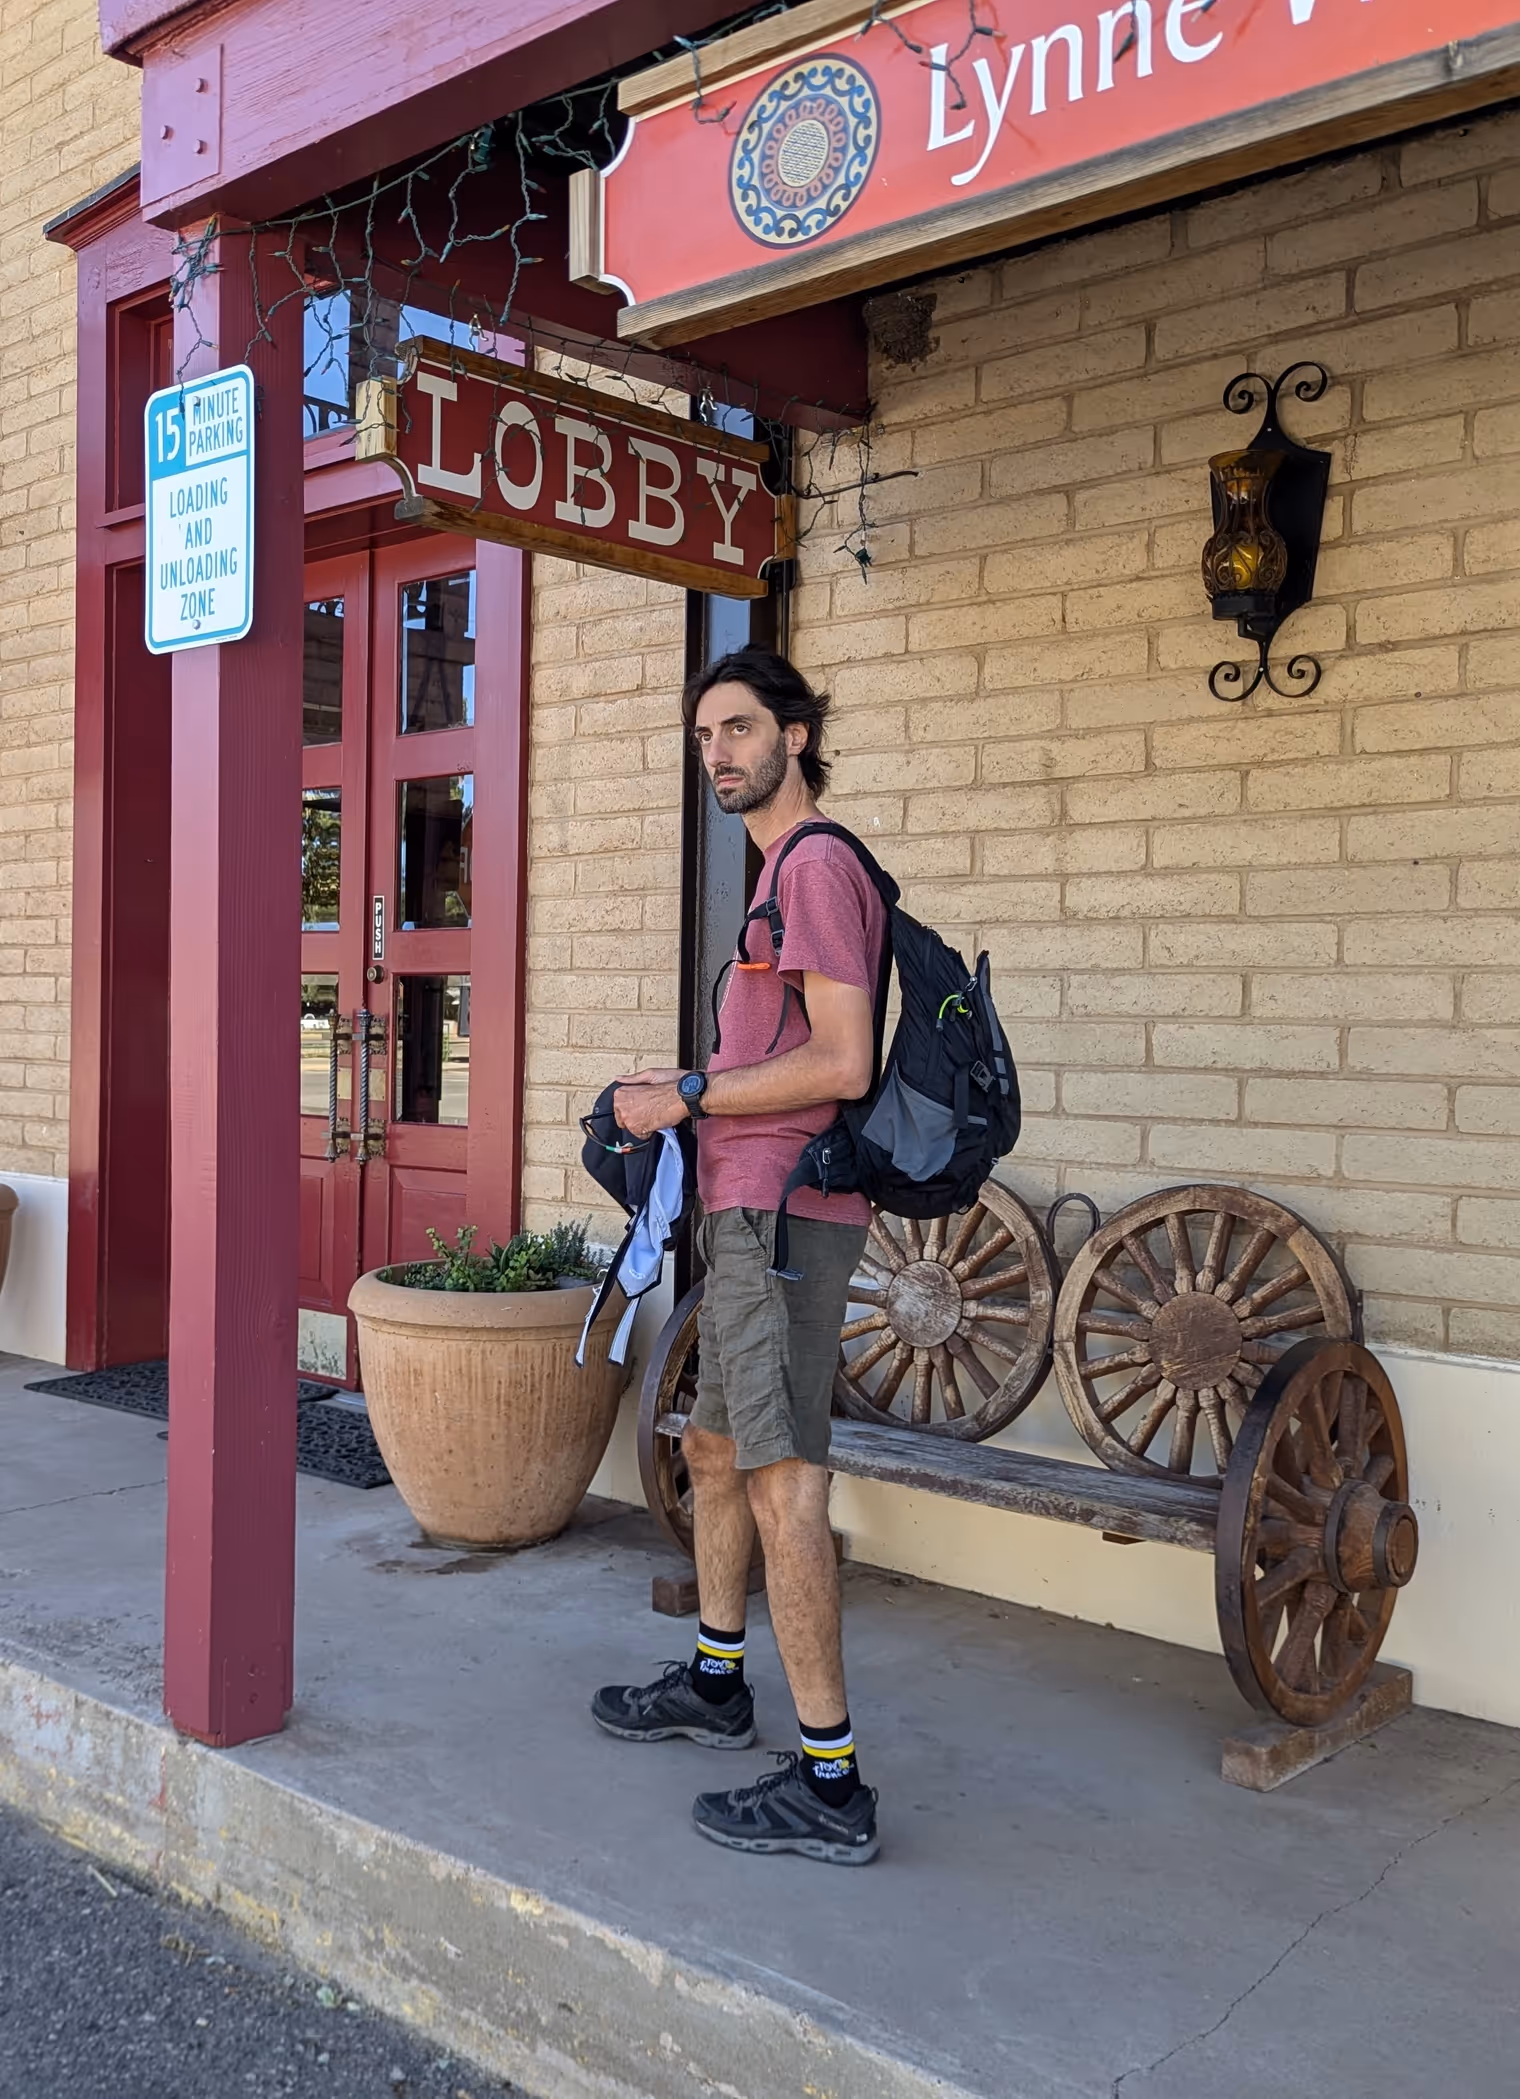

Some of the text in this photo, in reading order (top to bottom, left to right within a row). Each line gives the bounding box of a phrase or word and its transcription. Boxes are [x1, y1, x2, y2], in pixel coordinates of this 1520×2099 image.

[927, 0, 1224, 185] Lynne
[192, 387, 240, 426] MINUTE
[155, 407, 181, 465] 15
[188, 416, 244, 458] PARKING
[416, 371, 757, 566] LOBBY
[169, 477, 229, 519] LOADING
[184, 517, 213, 550] AND
[160, 547, 238, 591] UNLOADING
[180, 588, 216, 622] ZONE
[374, 901, 382, 954] PUSH
